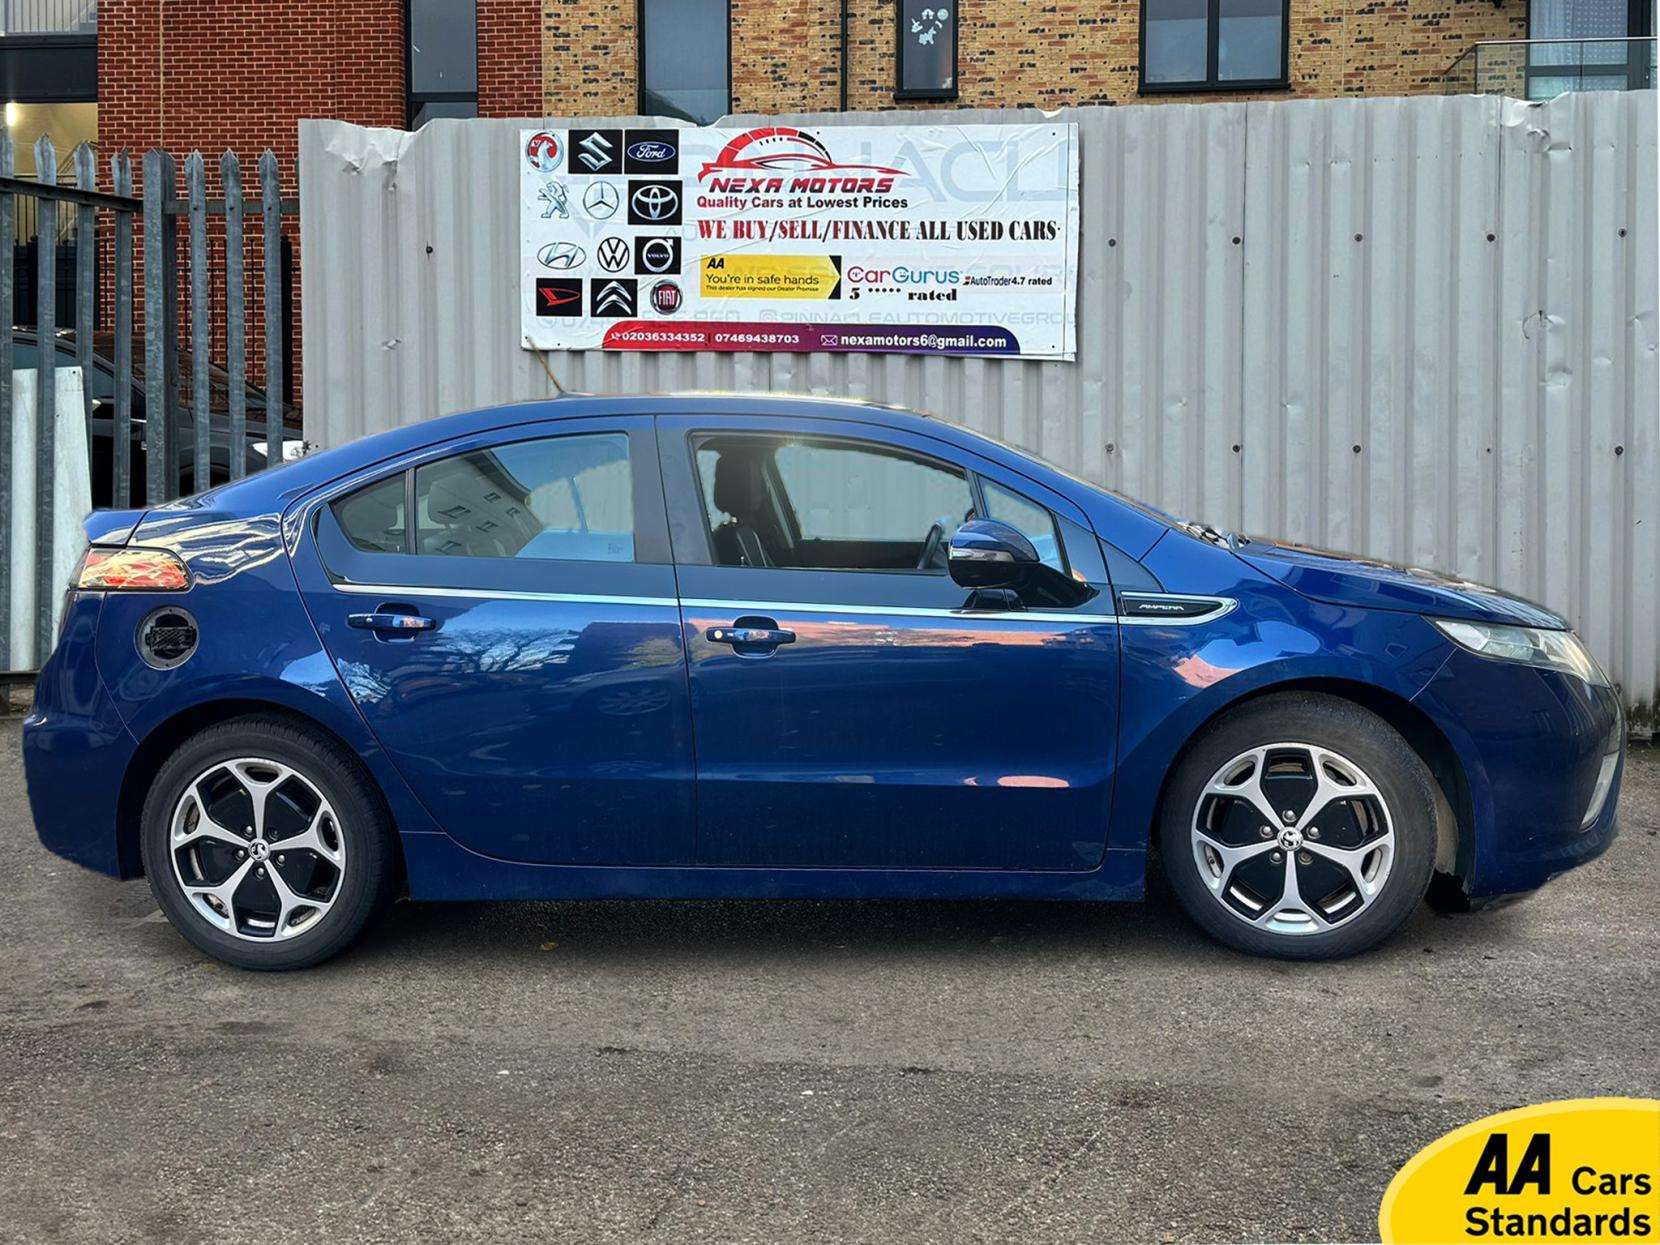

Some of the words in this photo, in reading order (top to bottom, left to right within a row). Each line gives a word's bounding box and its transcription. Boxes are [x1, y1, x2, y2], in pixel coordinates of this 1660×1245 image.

[636, 144, 666, 159] Ford
[709, 177, 784, 194] NEXA
[789, 177, 894, 194] MOTORS
[697, 195, 748, 211] Quality
[752, 196, 784, 209] Cars
[788, 197, 802, 209] at
[807, 196, 859, 209] Lowest
[863, 196, 908, 209] Prices
[697, 219, 728, 239] WE
[916, 220, 950, 241] ALL
[957, 220, 1004, 241] USED
[1009, 220, 1057, 241] CARS
[706, 257, 725, 269] AA
[705, 273, 741, 284] You're
[744, 274, 754, 284] in
[757, 273, 781, 285] safe
[784, 274, 819, 285] hands
[1028, 276, 1052, 286] rated
[658, 289, 676, 306] FIAT
[849, 287, 860, 300] 5
[908, 288, 957, 301] rated
[622, 332, 705, 342] 02036334352
[715, 333, 800, 344] 07469438703
[841, 334, 1007, 349] nexamotors6@gmail.com
